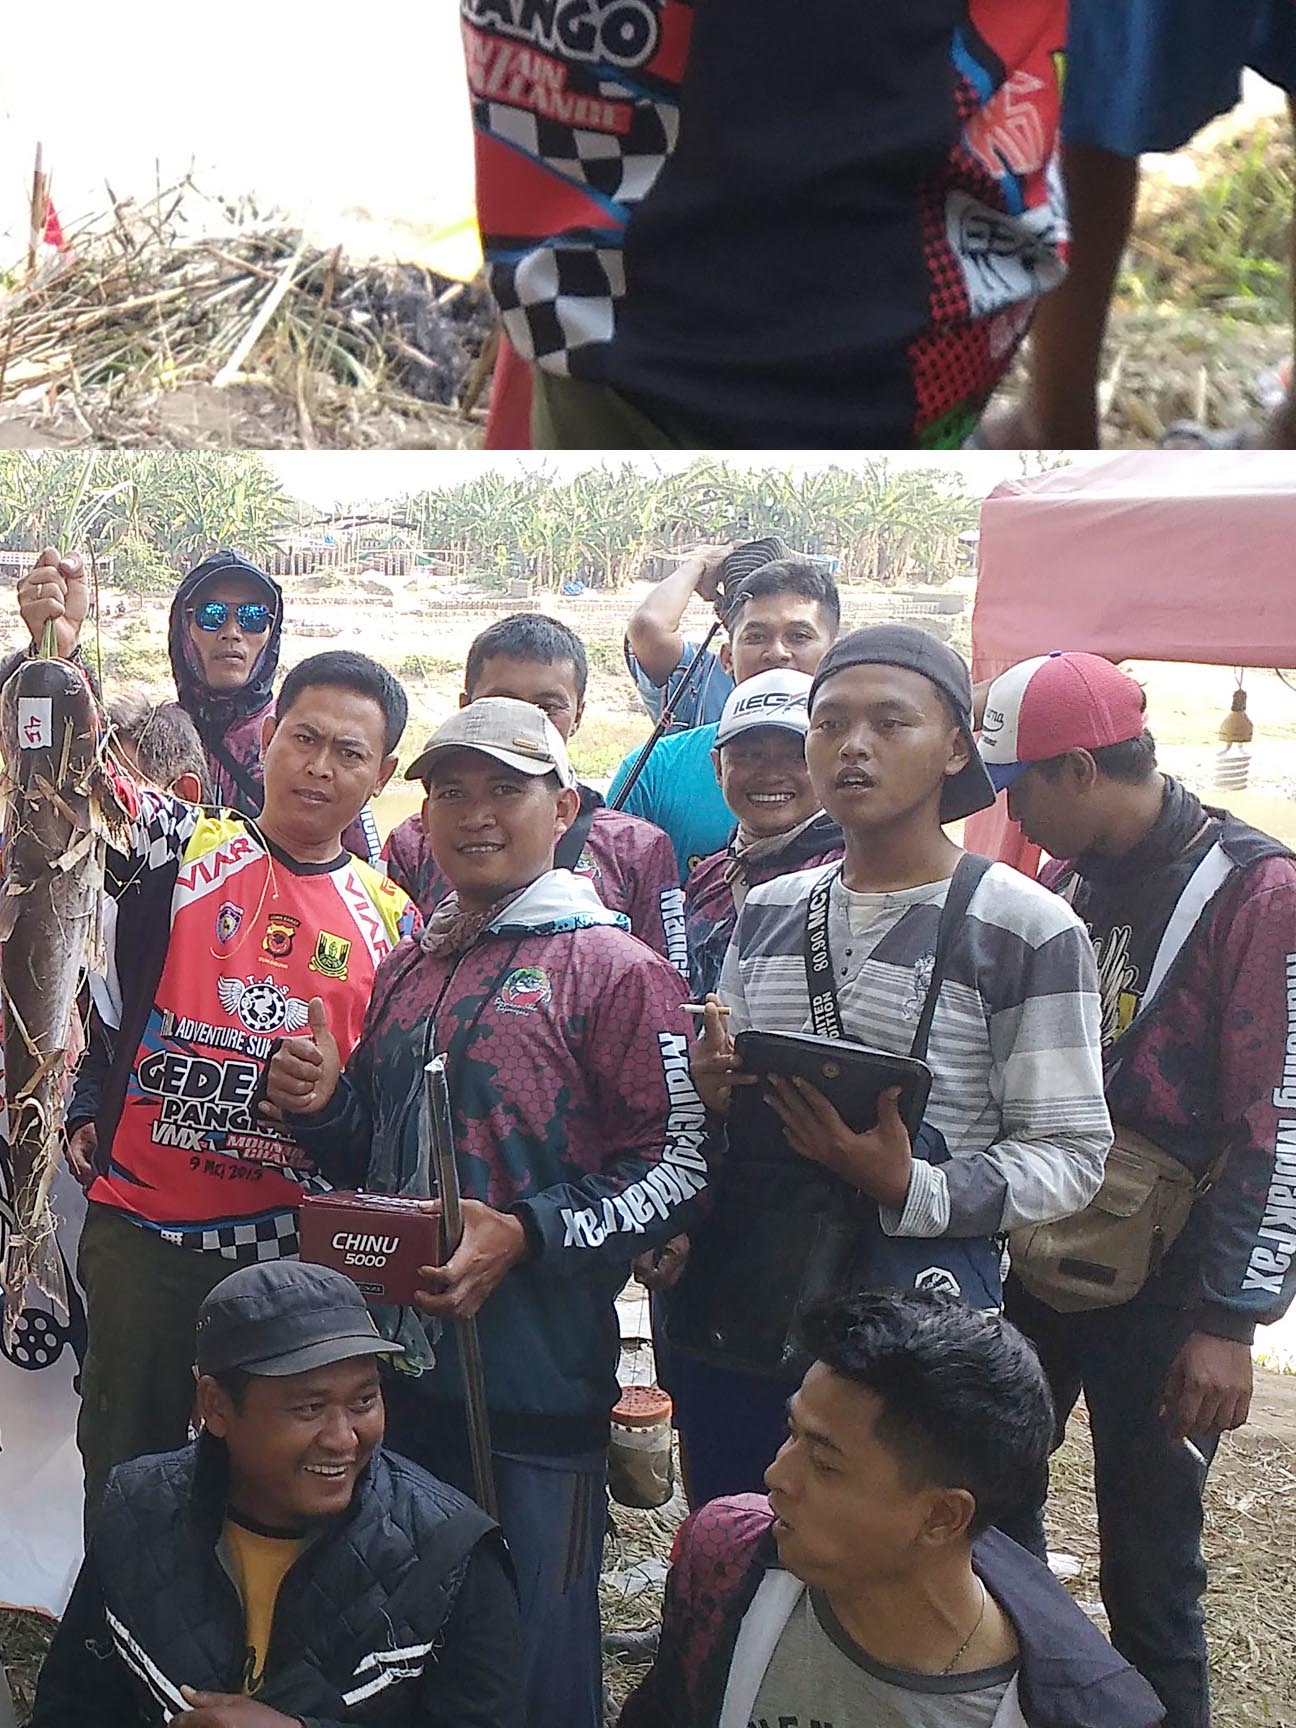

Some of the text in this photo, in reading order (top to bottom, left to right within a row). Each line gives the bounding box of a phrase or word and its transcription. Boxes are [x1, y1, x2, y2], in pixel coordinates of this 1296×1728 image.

[732, 691, 810, 717] ILEGA
[176, 837, 255, 892] VIAR
[812, 994, 829, 1038] MITED
[821, 990, 841, 1040] DITION
[175, 1016, 246, 1052] ADVENTURE
[137, 1049, 260, 1110] GEDE
[151, 1120, 206, 1153] VMX
[331, 1232, 400, 1254] CHINU
[344, 1252, 387, 1268] 5000
